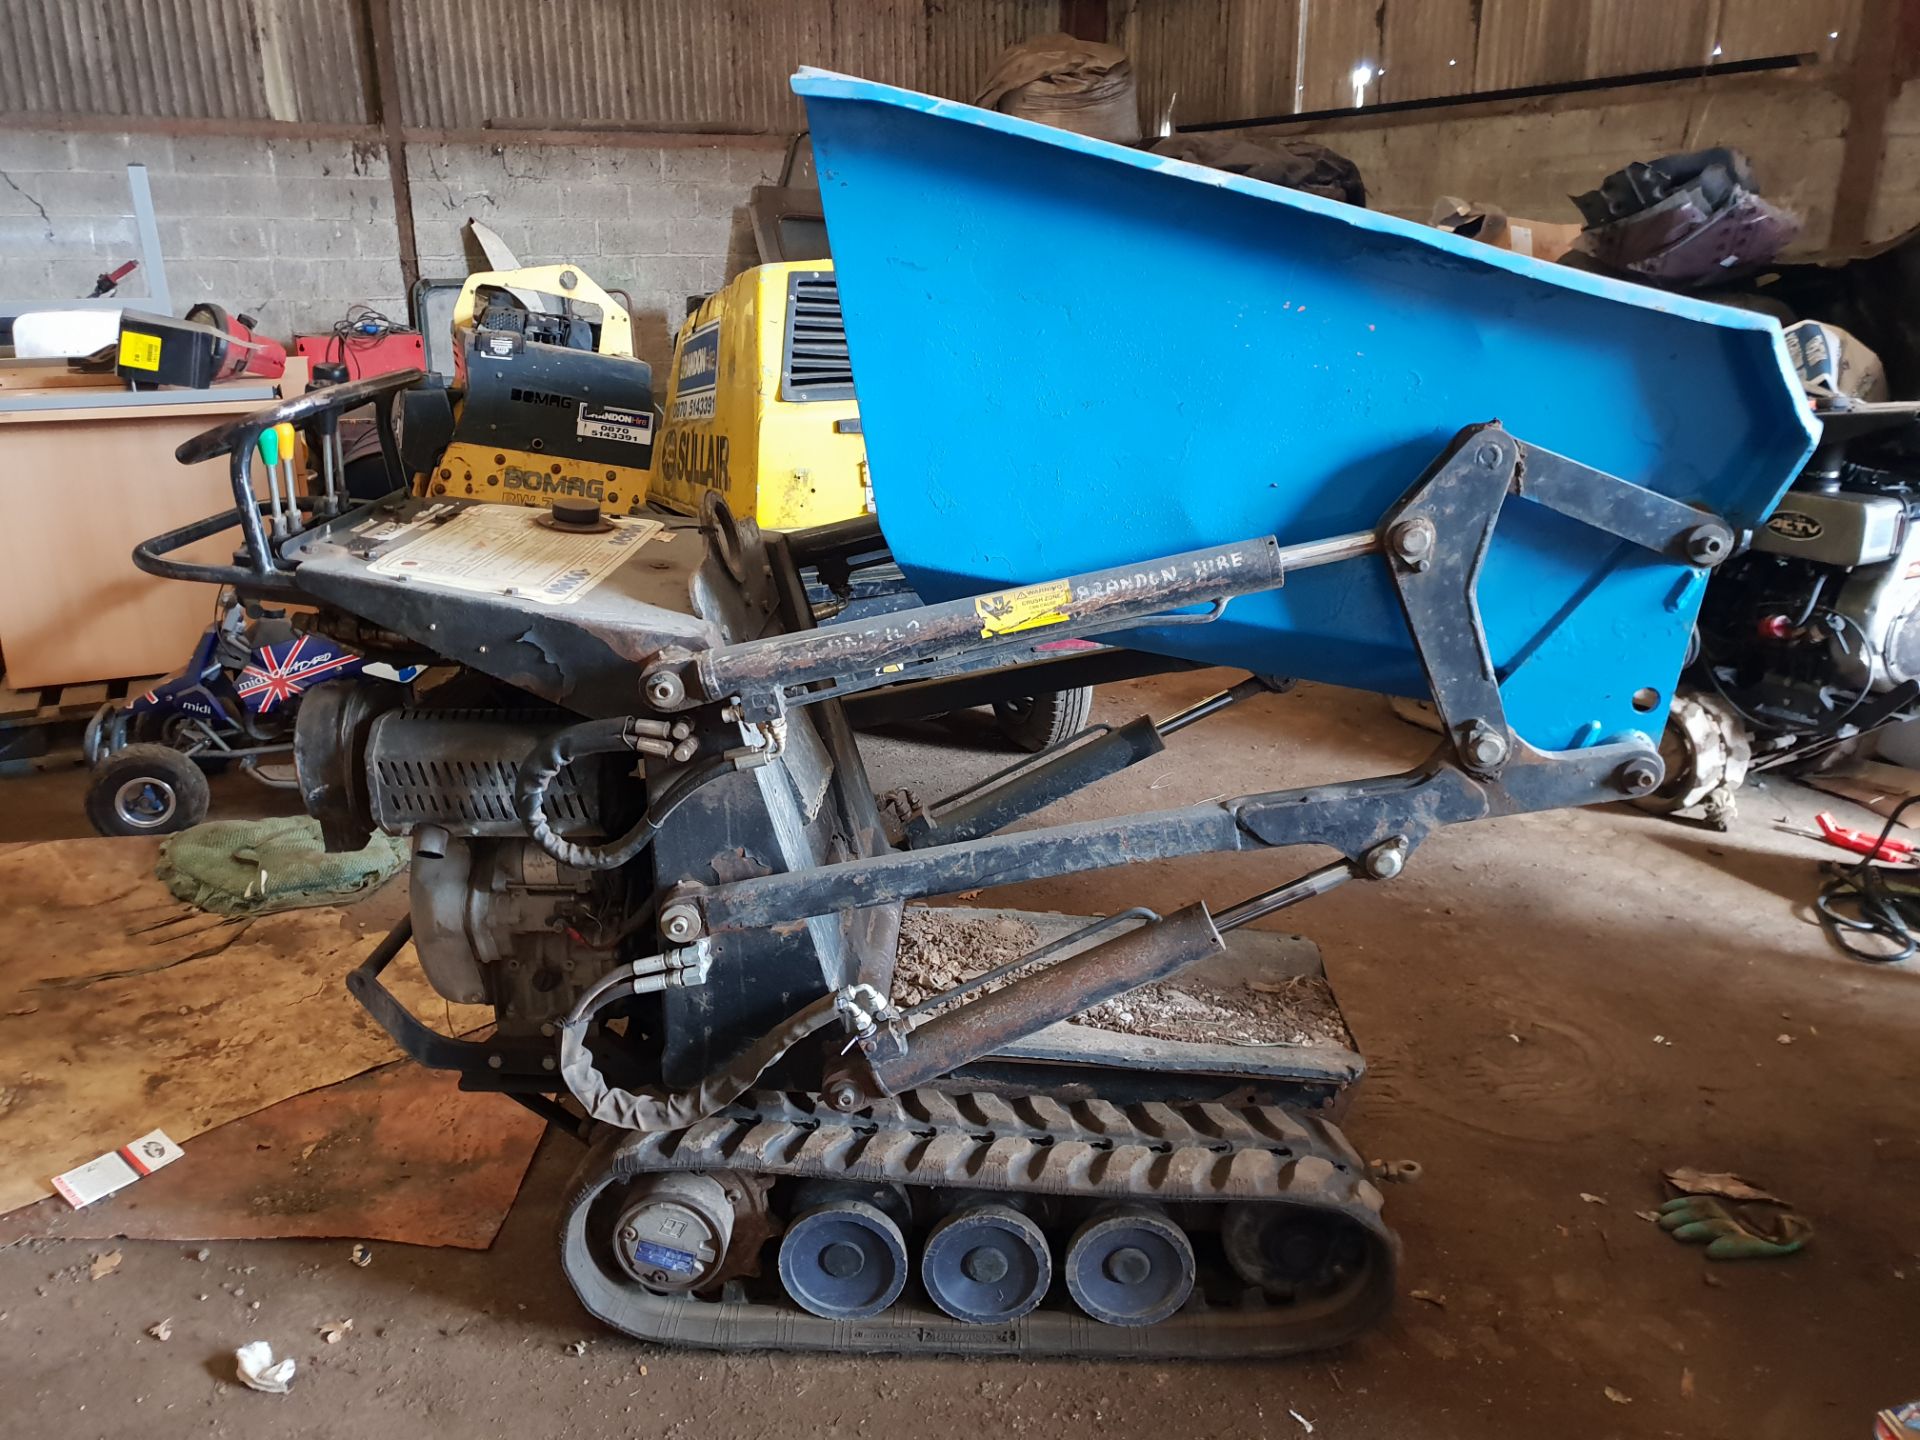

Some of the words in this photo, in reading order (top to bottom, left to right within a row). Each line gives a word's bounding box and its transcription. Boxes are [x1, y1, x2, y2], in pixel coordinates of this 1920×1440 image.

[511, 388, 573, 409] BOMAG
[672, 401, 688, 419] 0870
[689, 395, 716, 417] 5143391
[591, 430, 639, 442] 5143391
[600, 425, 630, 434] 0870
[677, 430, 730, 492] SULLAIR
[504, 465, 604, 501] BOMAG
[182, 701, 212, 715] midi
